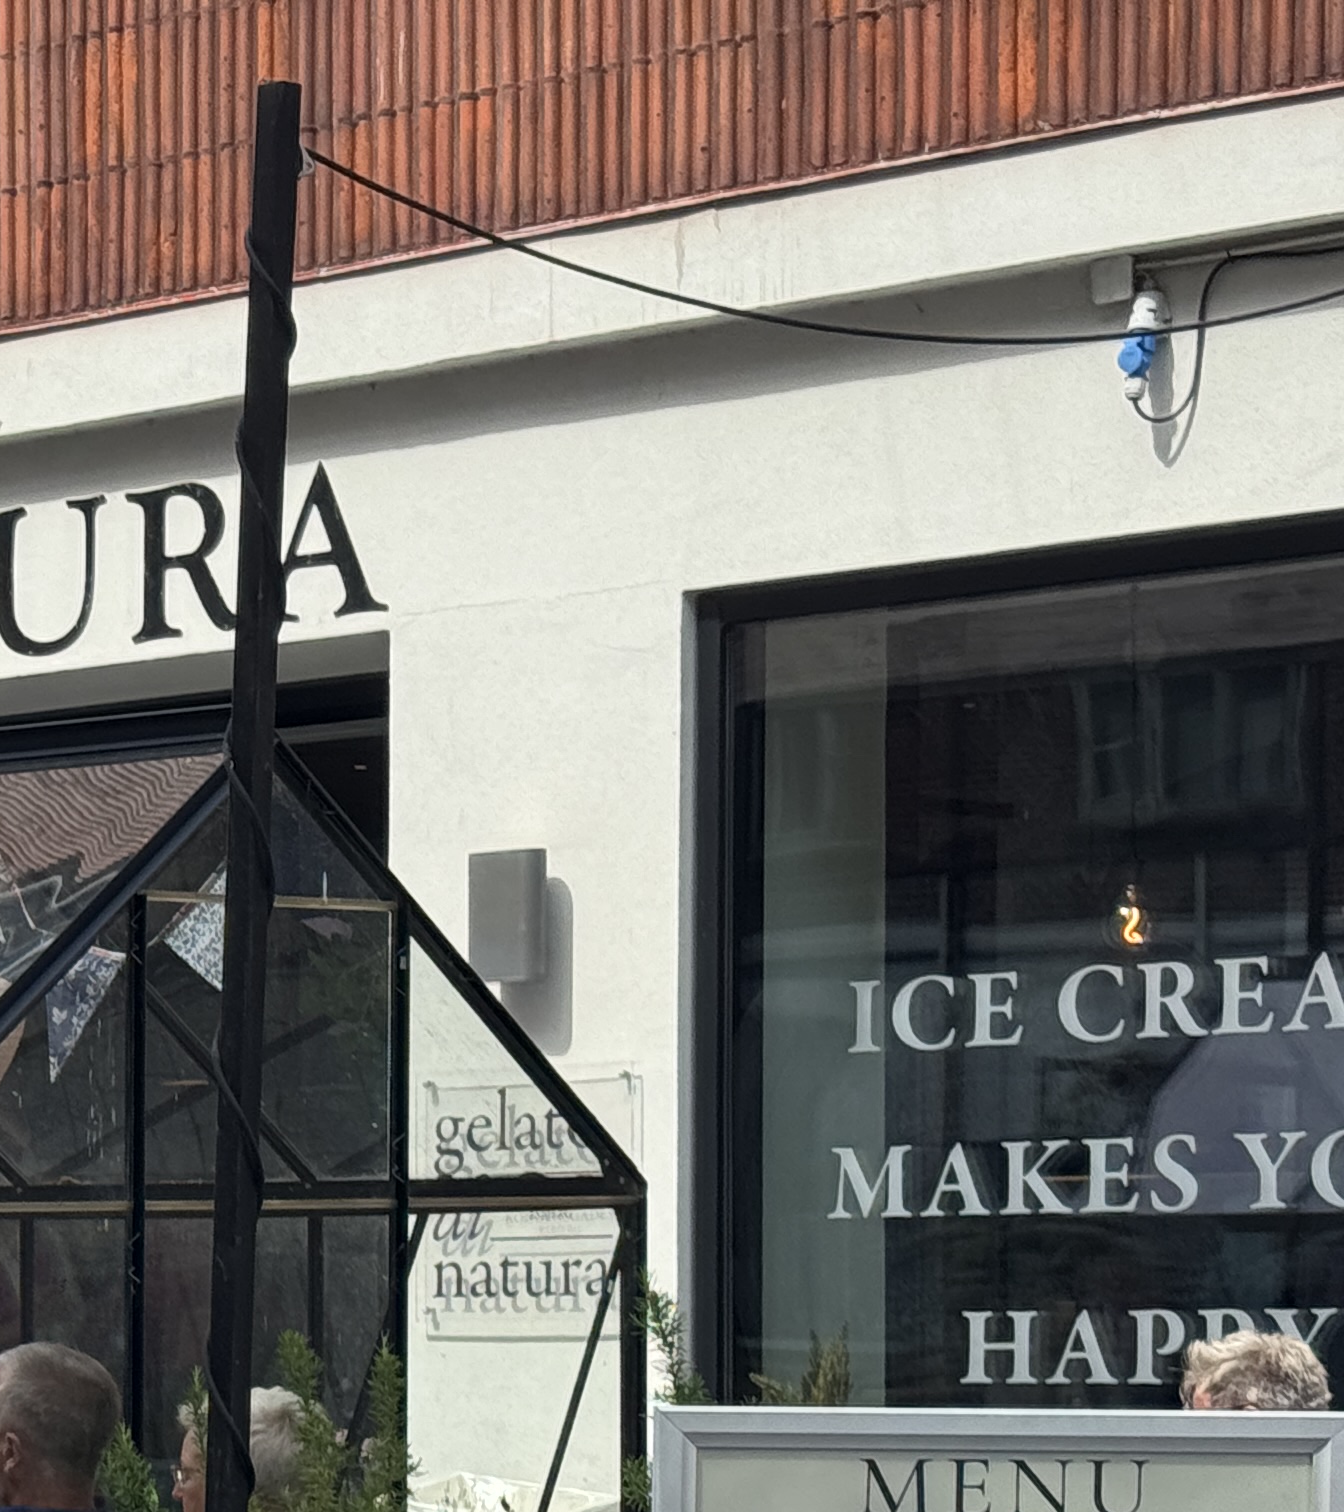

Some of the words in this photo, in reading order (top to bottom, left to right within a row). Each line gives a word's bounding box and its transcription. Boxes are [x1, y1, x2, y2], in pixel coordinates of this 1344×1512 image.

[847, 971, 1024, 1054] ICE
[827, 1133, 1200, 1219] MAKES
[433, 1256, 616, 1298] natura
